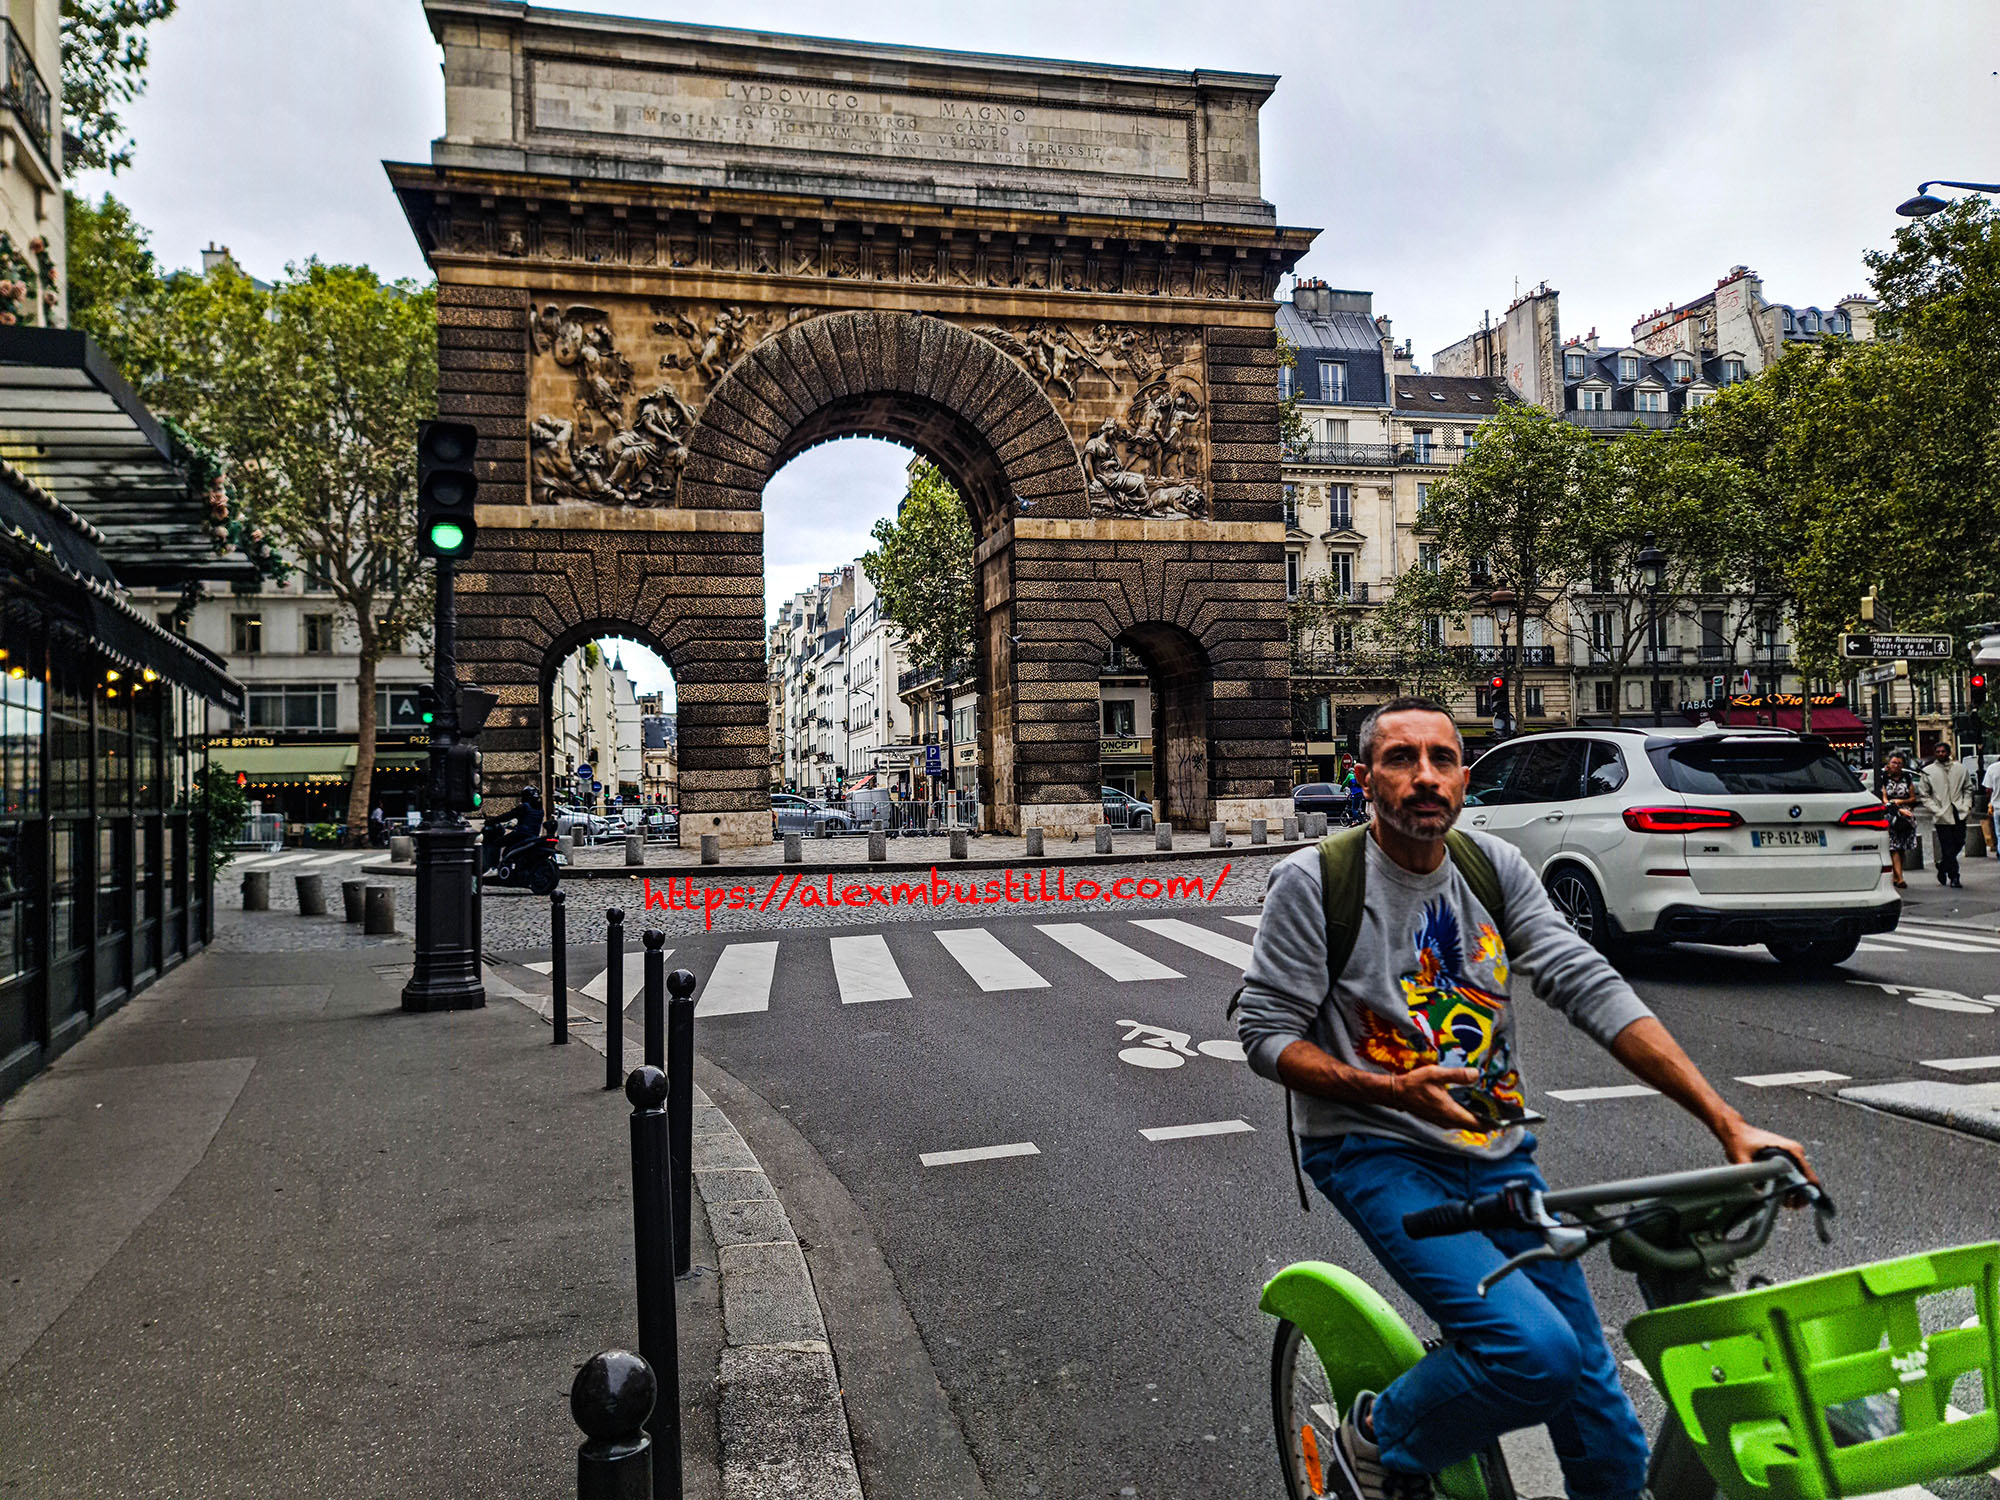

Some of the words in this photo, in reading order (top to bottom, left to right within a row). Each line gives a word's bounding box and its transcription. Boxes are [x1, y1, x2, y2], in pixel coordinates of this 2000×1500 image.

[724, 83, 858, 108] LVDOVICO
[943, 103, 1026, 122] MAGNO
[744, 105, 793, 118] QVOD
[956, 123, 1009, 136] CAPTO
[636, 108, 754, 130] IMPOTENTES
[773, 122, 851, 138] HOSTIVM
[870, 130, 920, 144] MINAS
[1018, 142, 1102, 158] REPRESSIT
[1681, 699, 1713, 710] TABAC
[1732, 694, 1762, 706] La
[410, 735, 430, 744] PIZZ
[1101, 740, 1139, 749] ONCEPT
[930, 748, 936, 758] P
[1760, 831, 1819, 845] FP-612-BN
